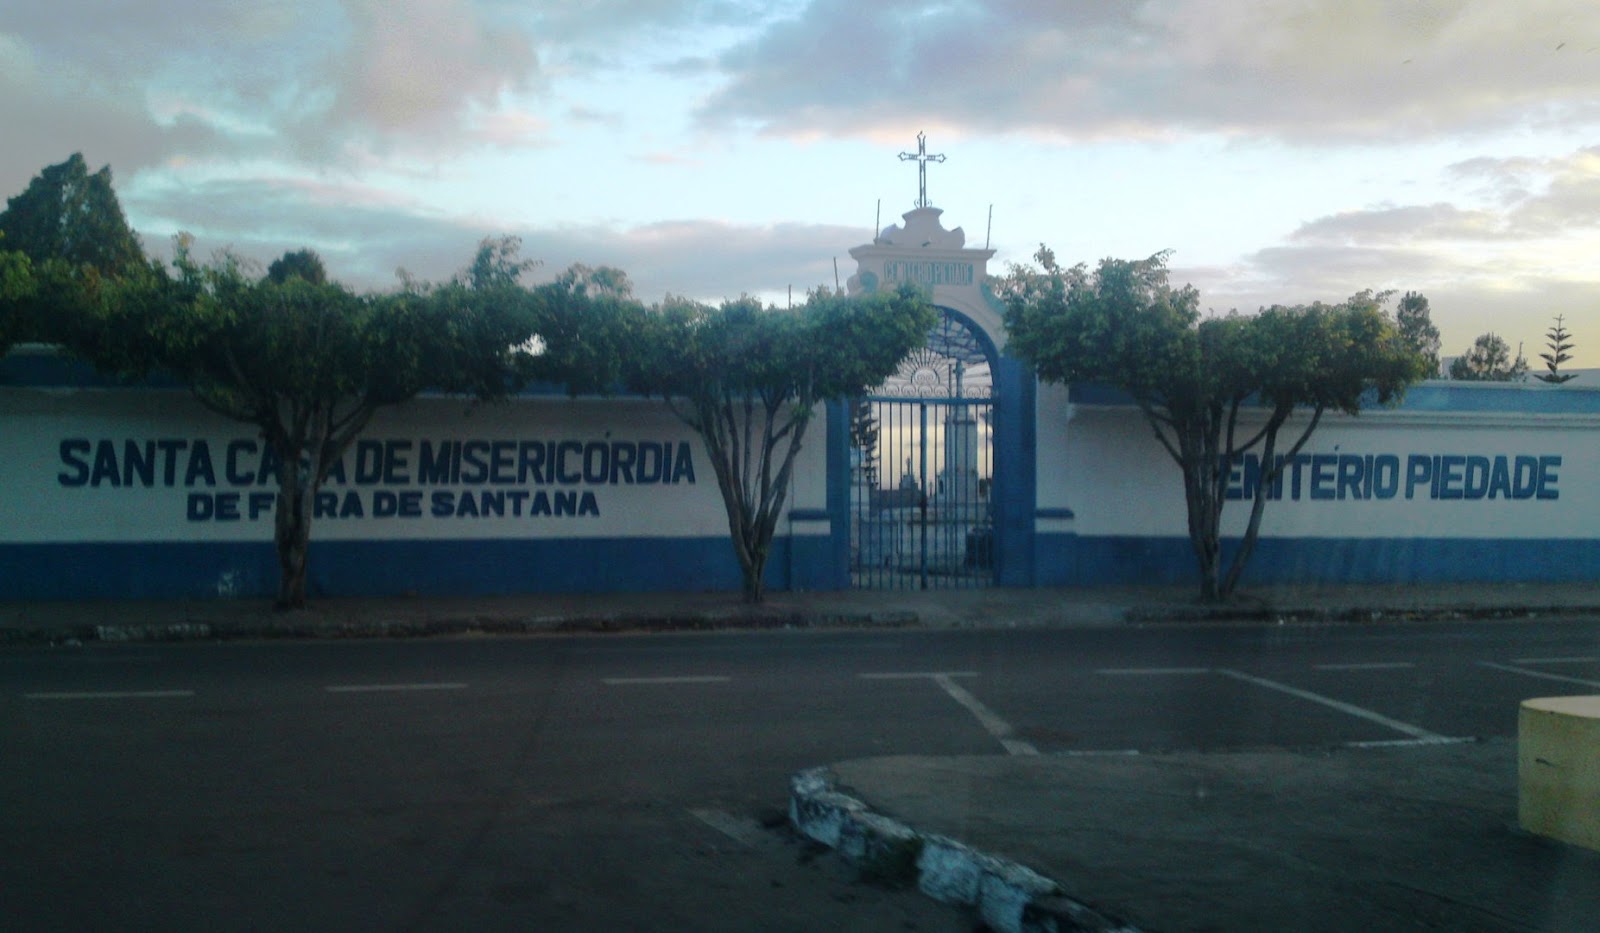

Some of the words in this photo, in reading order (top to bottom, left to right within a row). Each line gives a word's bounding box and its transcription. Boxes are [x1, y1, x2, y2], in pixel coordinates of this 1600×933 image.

[57, 438, 216, 488] SANTA
[354, 439, 411, 486] DE
[417, 430, 696, 486] MISERICÓRDIA
[1198, 444, 1400, 501] EMITÉRIO
[1404, 454, 1563, 501] PIEDADE
[186, 491, 241, 522] DE
[248, 490, 365, 520] FRA
[371, 490, 423, 519] DE
[430, 490, 601, 518] SANTANA
